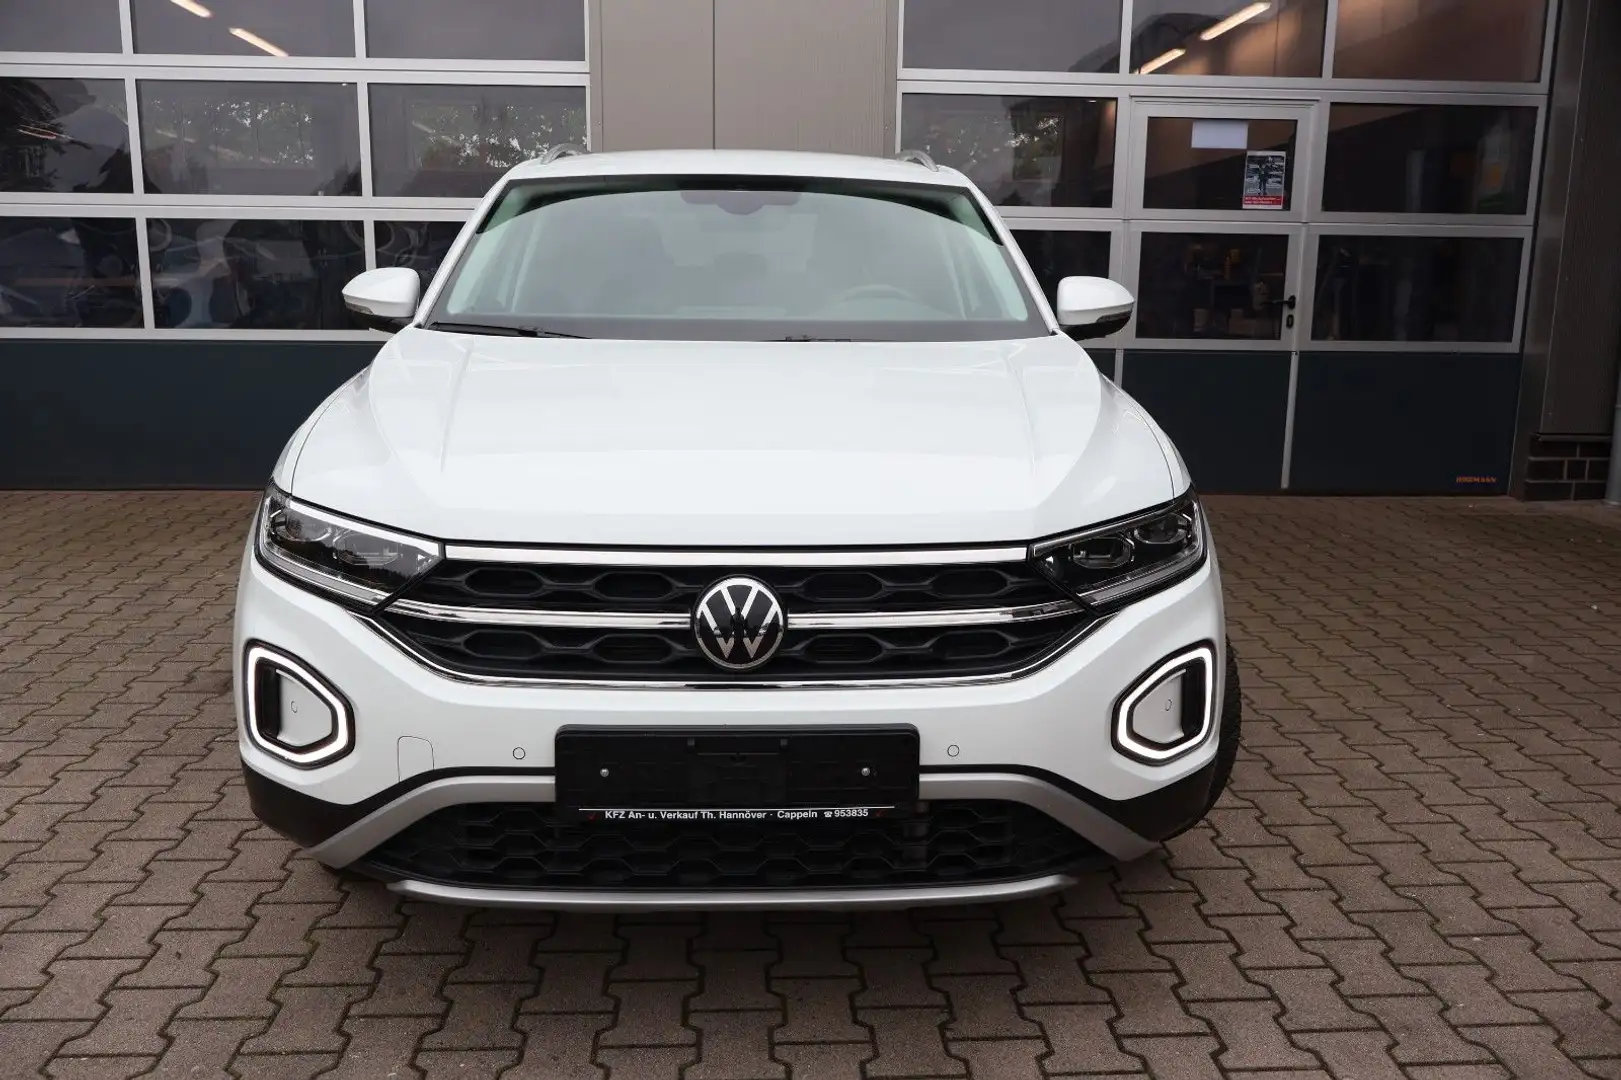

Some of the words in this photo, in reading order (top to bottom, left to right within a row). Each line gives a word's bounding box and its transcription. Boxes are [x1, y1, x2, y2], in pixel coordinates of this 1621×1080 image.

[696, 577, 783, 668] VW
[605, 810, 626, 819] KFZ
[628, 811, 646, 819] An-
[660, 811, 698, 819] Verkauf
[700, 811, 716, 819] Th.
[719, 810, 767, 819] Hannöver
[777, 810, 818, 820] Cappeln
[834, 809, 869, 818] 953835
